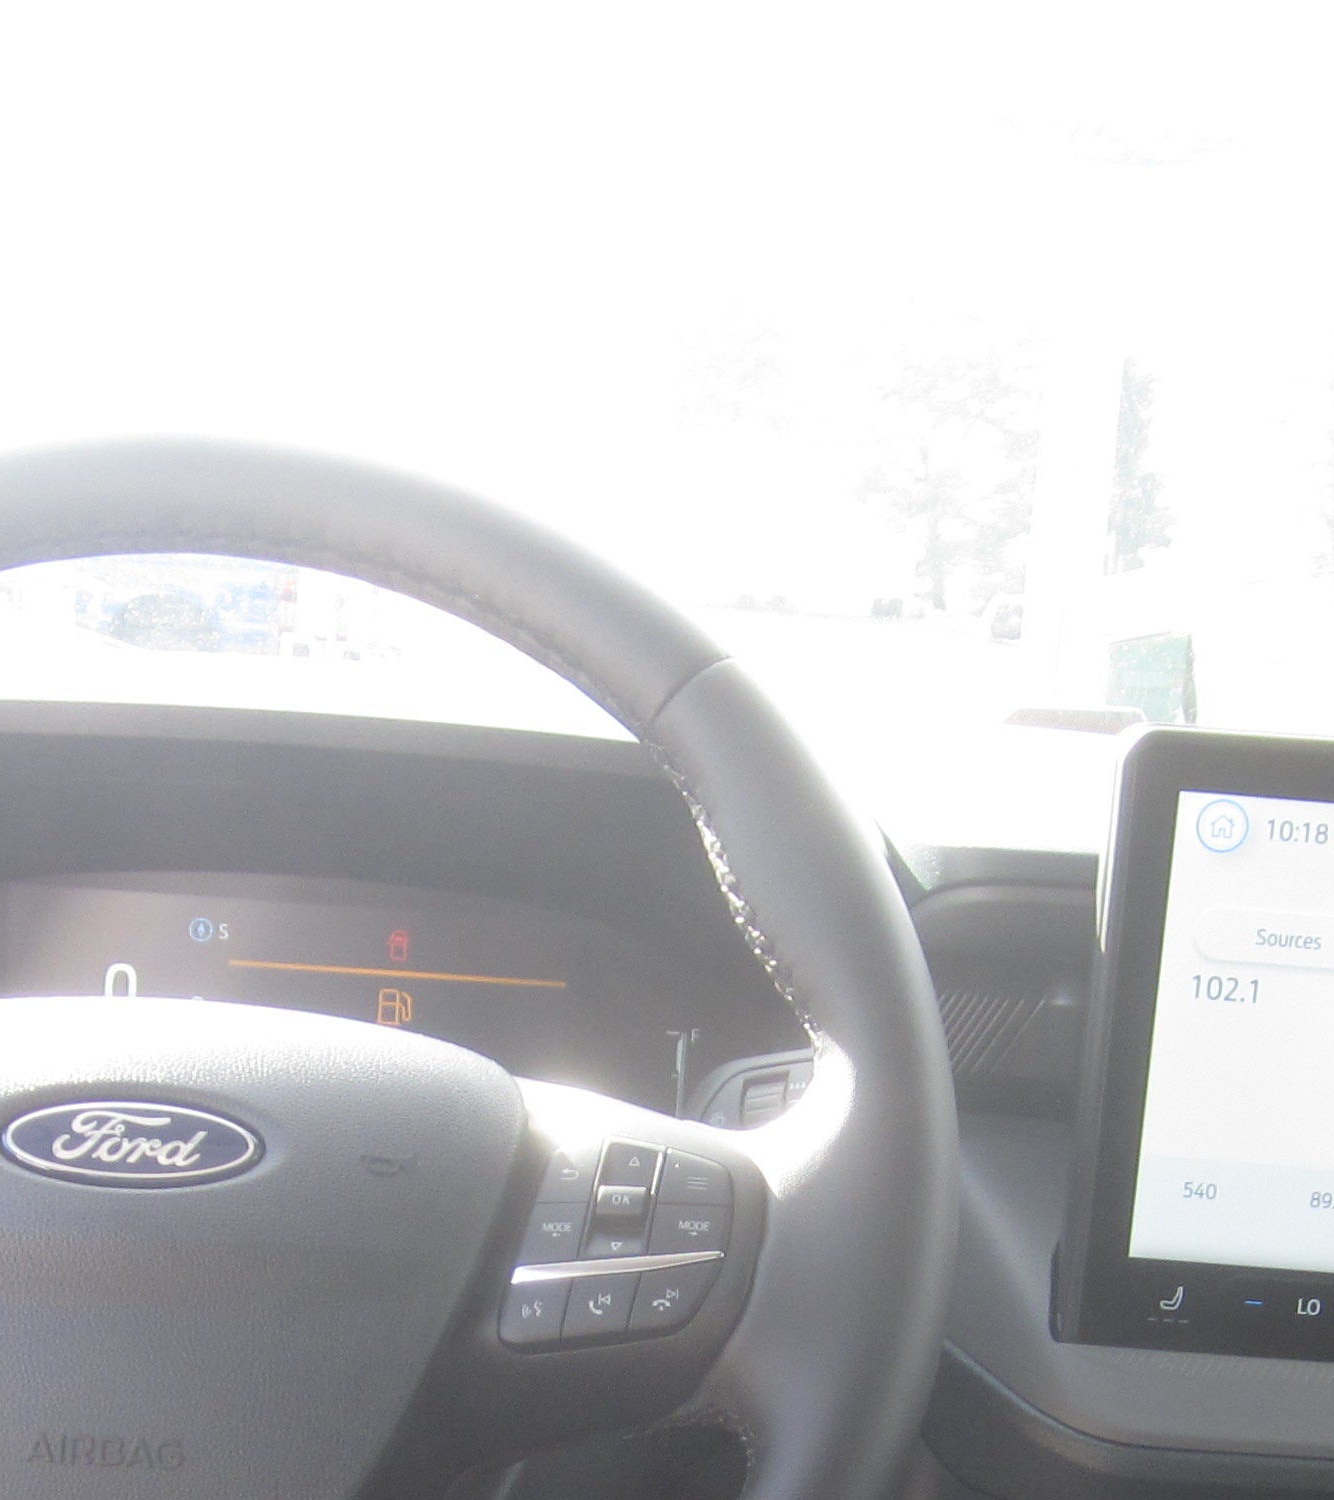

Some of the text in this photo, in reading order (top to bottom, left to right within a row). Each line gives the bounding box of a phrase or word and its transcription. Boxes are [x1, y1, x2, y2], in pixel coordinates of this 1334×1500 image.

[1266, 819, 1330, 845] 10:18
[1255, 928, 1323, 951] Sources
[1191, 974, 1261, 1004] 102.1
[53, 1110, 208, 1167] Ford
[612, 1193, 631, 1206] OK
[1182, 1181, 1217, 1200] 540
[542, 1221, 571, 1232] MODE
[678, 1219, 710, 1232] MODE
[1296, 1297, 1321, 1316] LO
[28, 1433, 187, 1473] AIRBAG
